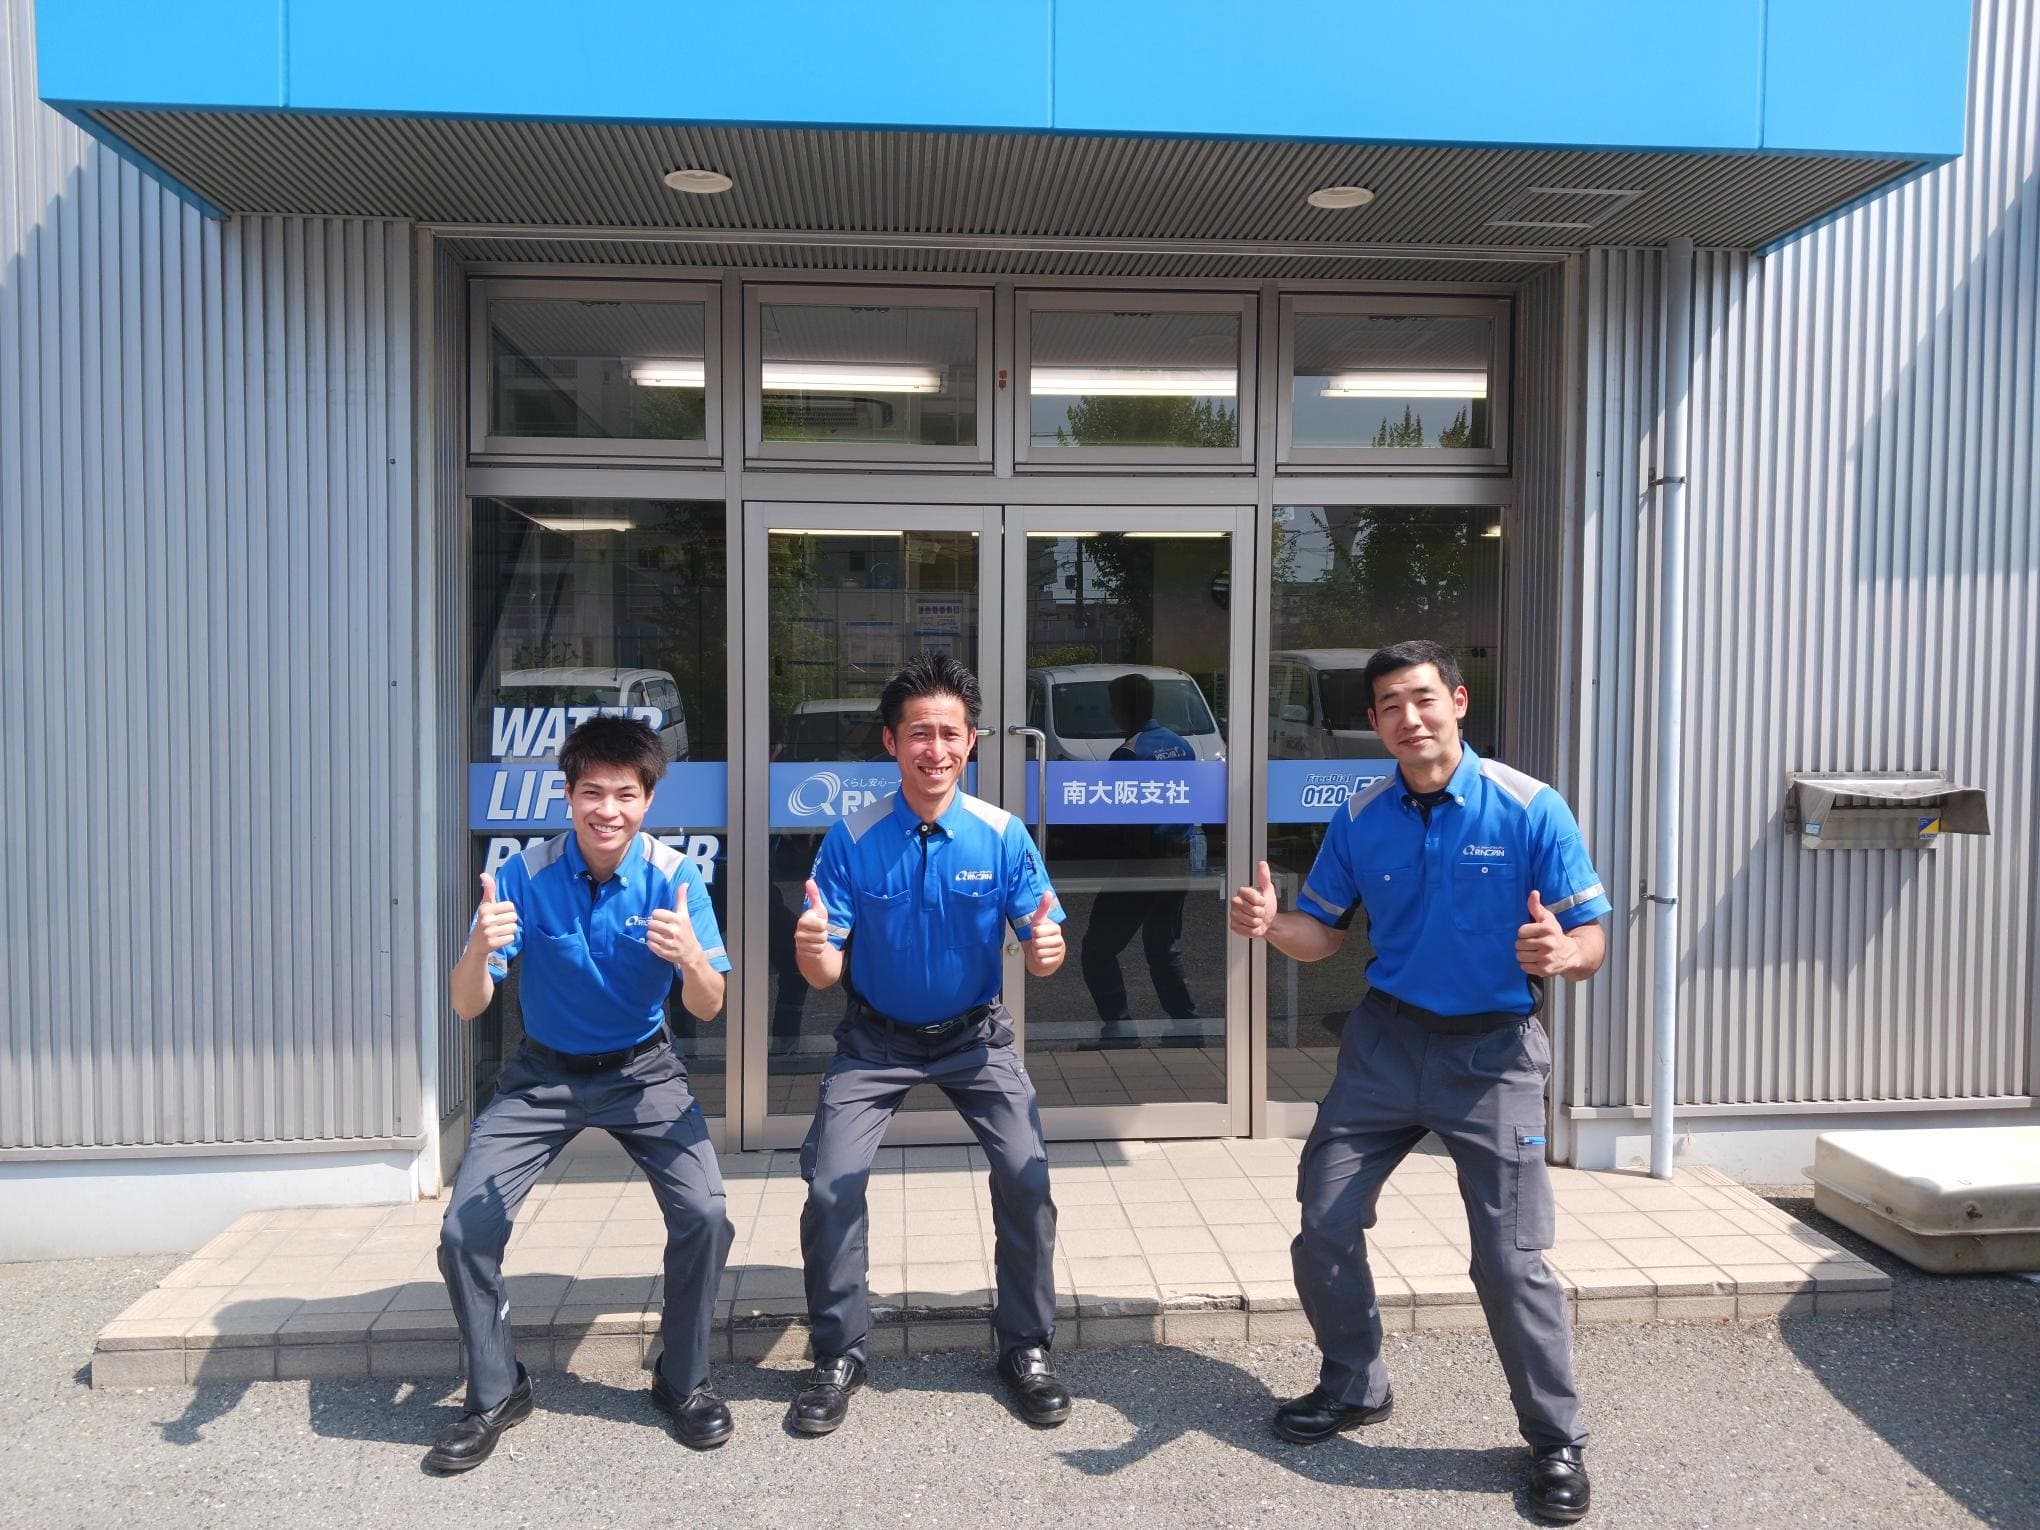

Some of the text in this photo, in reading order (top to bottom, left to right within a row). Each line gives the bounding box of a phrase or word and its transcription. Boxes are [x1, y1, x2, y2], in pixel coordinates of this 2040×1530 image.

[486, 770, 573, 820] LIF
[1062, 780, 1190, 805] 南大阪支社
